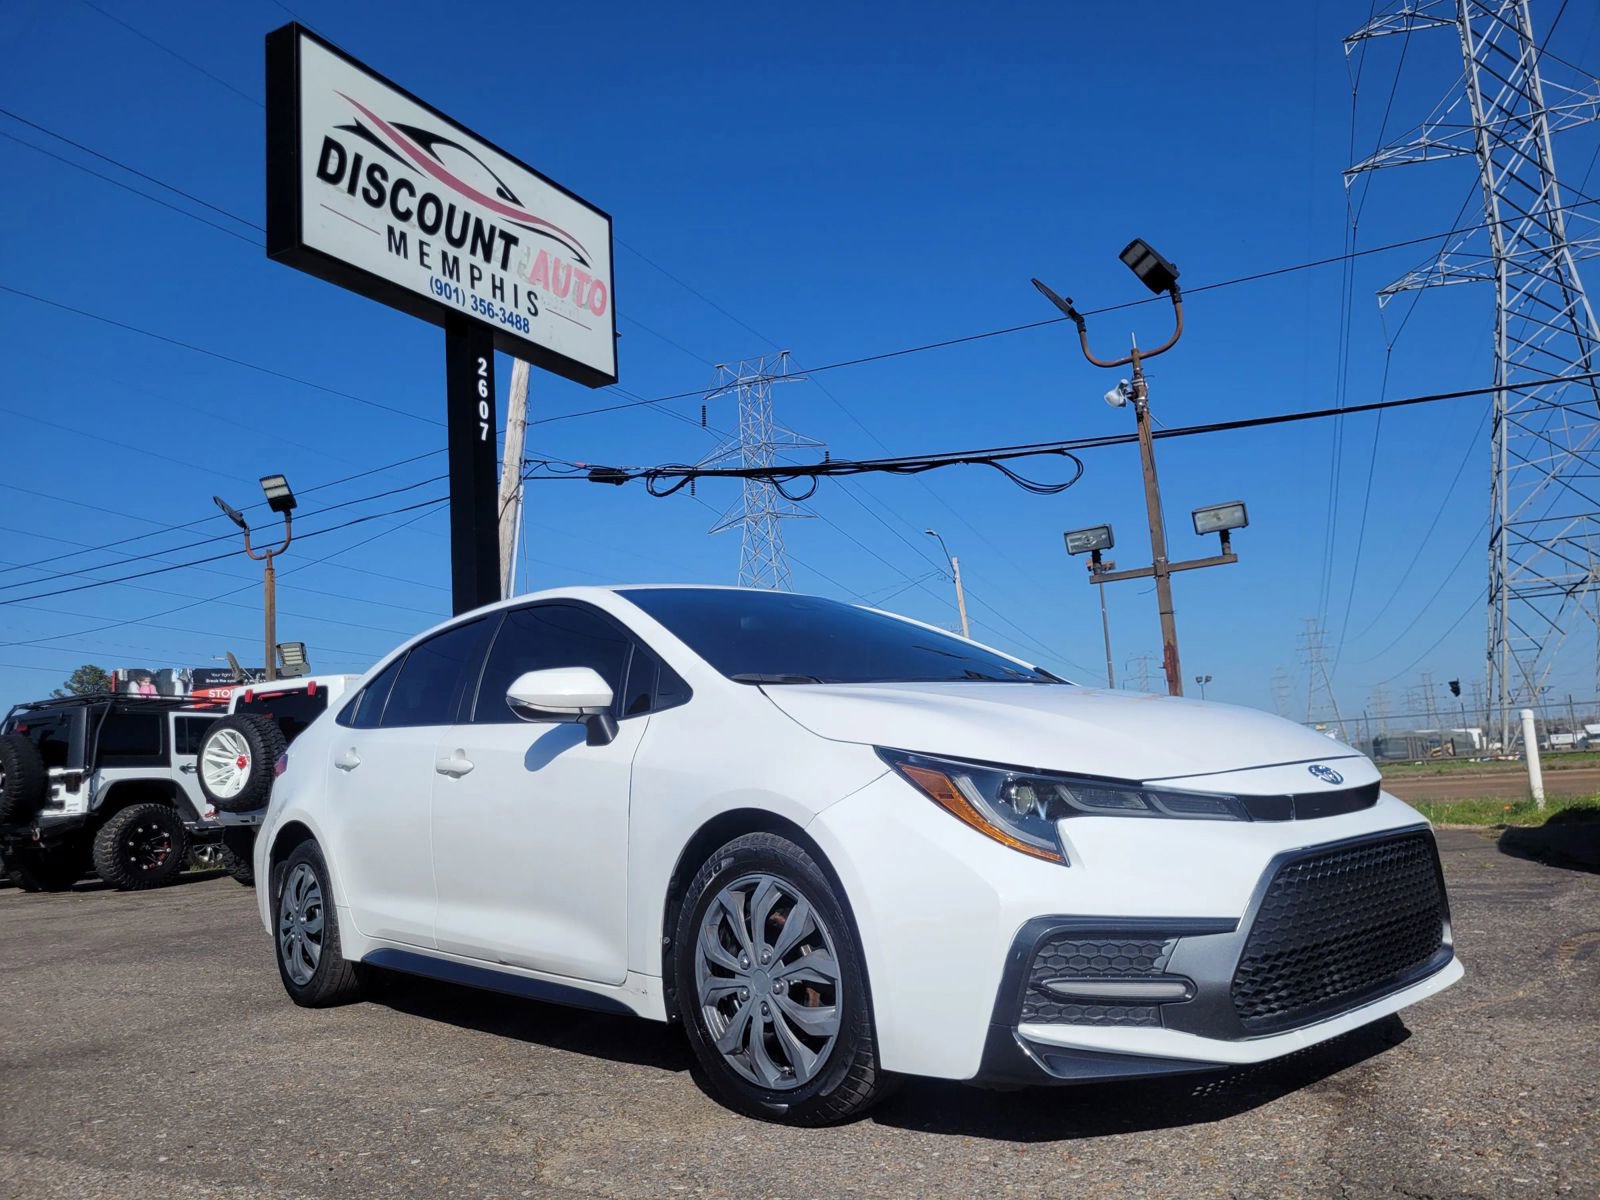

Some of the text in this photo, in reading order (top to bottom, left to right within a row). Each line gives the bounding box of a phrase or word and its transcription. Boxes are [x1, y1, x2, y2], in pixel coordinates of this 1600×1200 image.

[316, 135, 607, 317] DISCOUNT AUTO
[387, 224, 538, 317] MEMPHIS
[430, 276, 530, 334] (901) 356-3488
[477, 356, 489, 441] 2607
